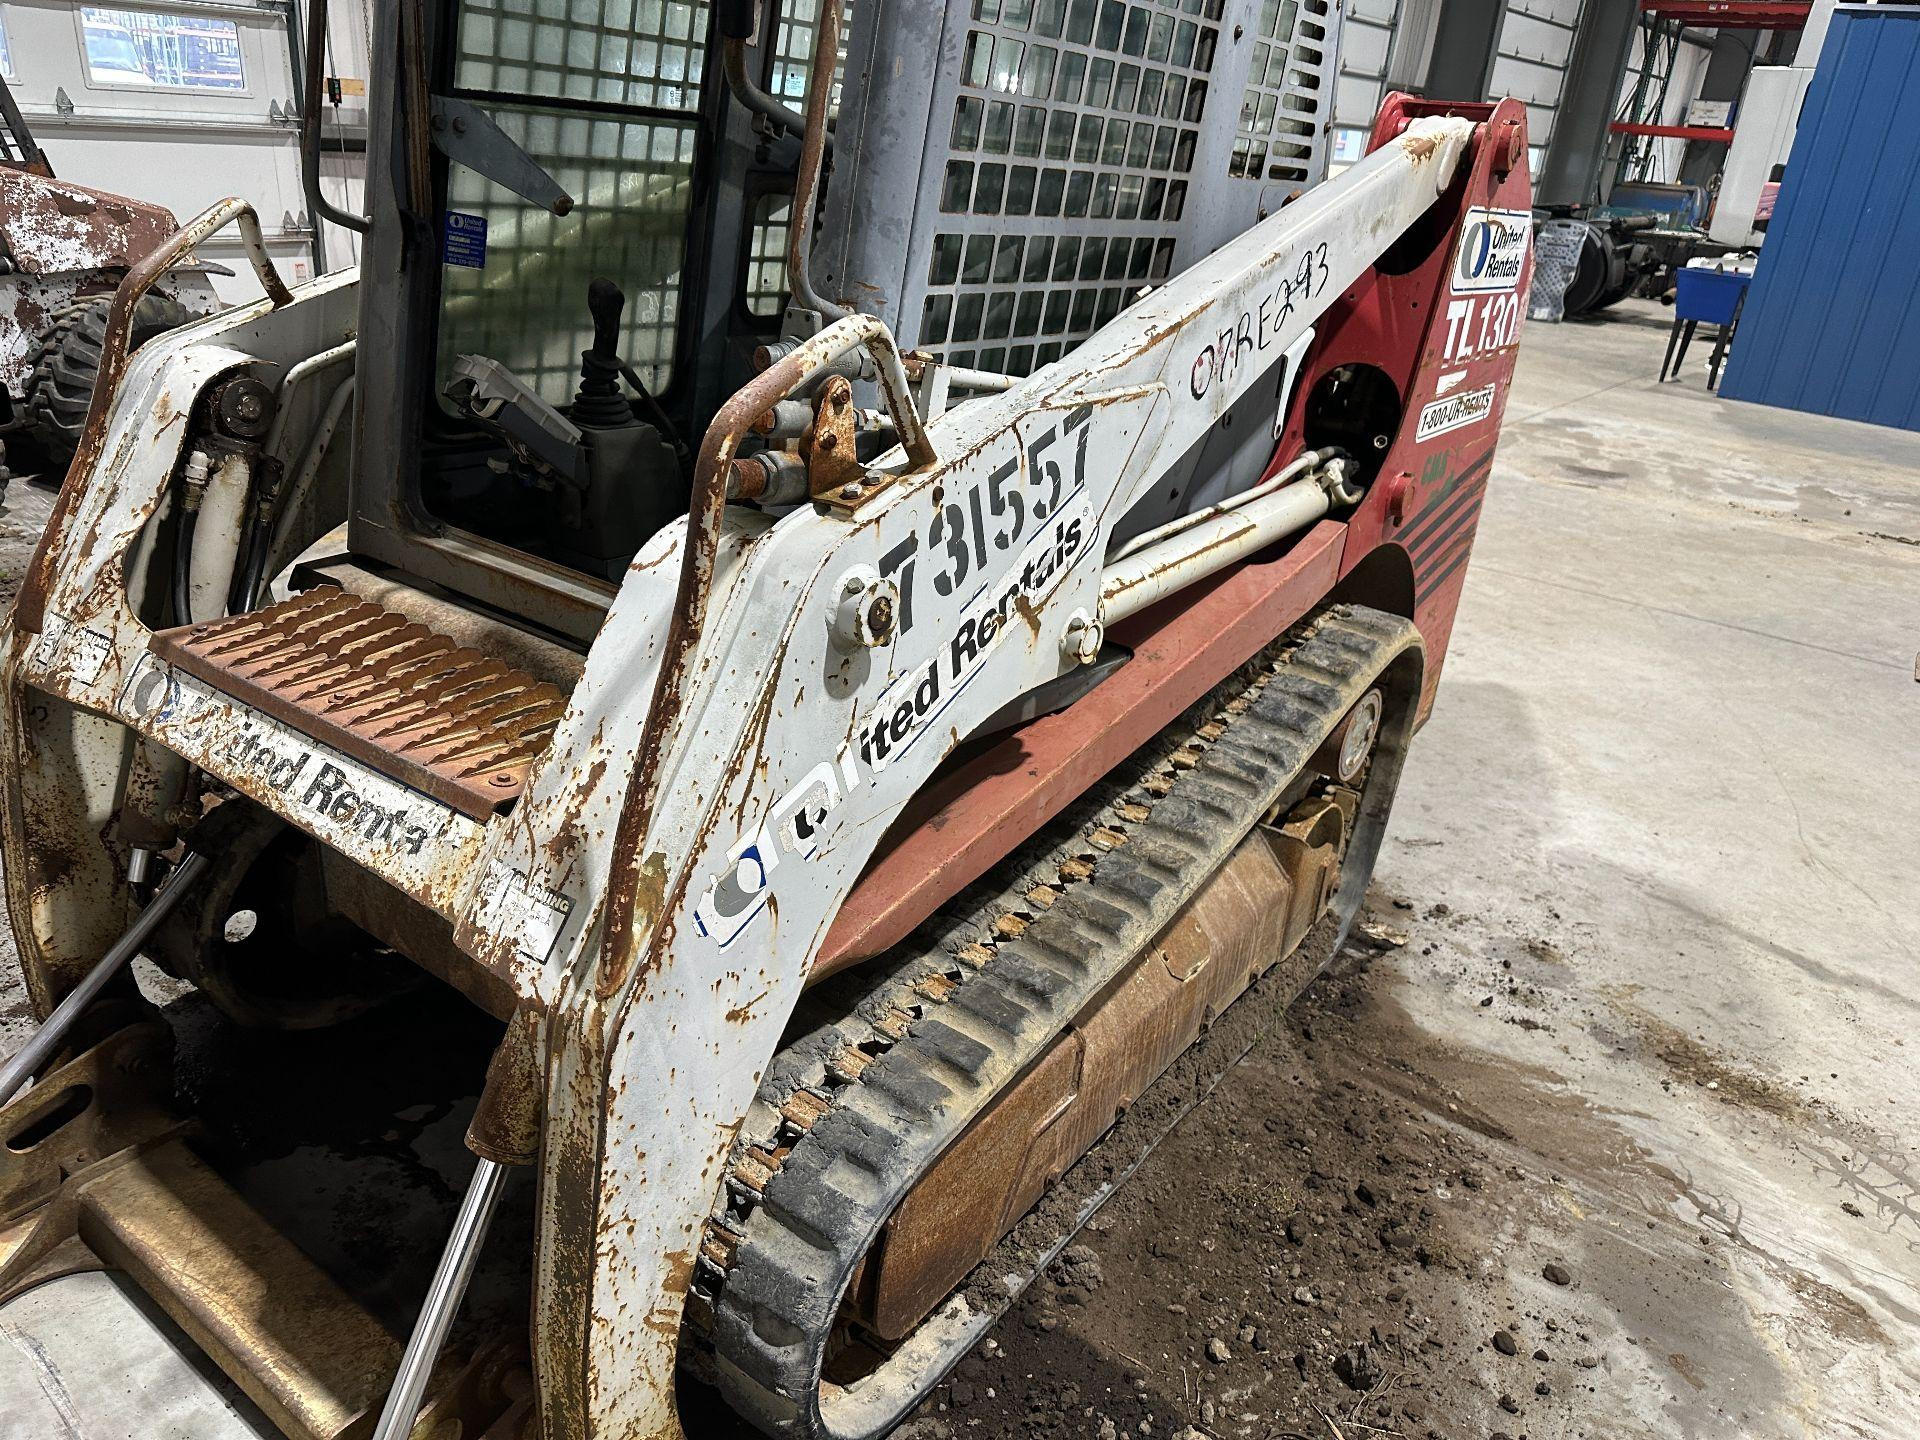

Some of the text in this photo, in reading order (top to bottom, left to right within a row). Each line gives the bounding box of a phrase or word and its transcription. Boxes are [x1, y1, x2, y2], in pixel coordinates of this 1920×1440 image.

[1485, 253, 1519, 278] Rentals
[1493, 225, 1525, 249] United
[878, 403, 1093, 636] 731557
[951, 518, 1082, 680] Rentals
[303, 762, 444, 856] Renta
